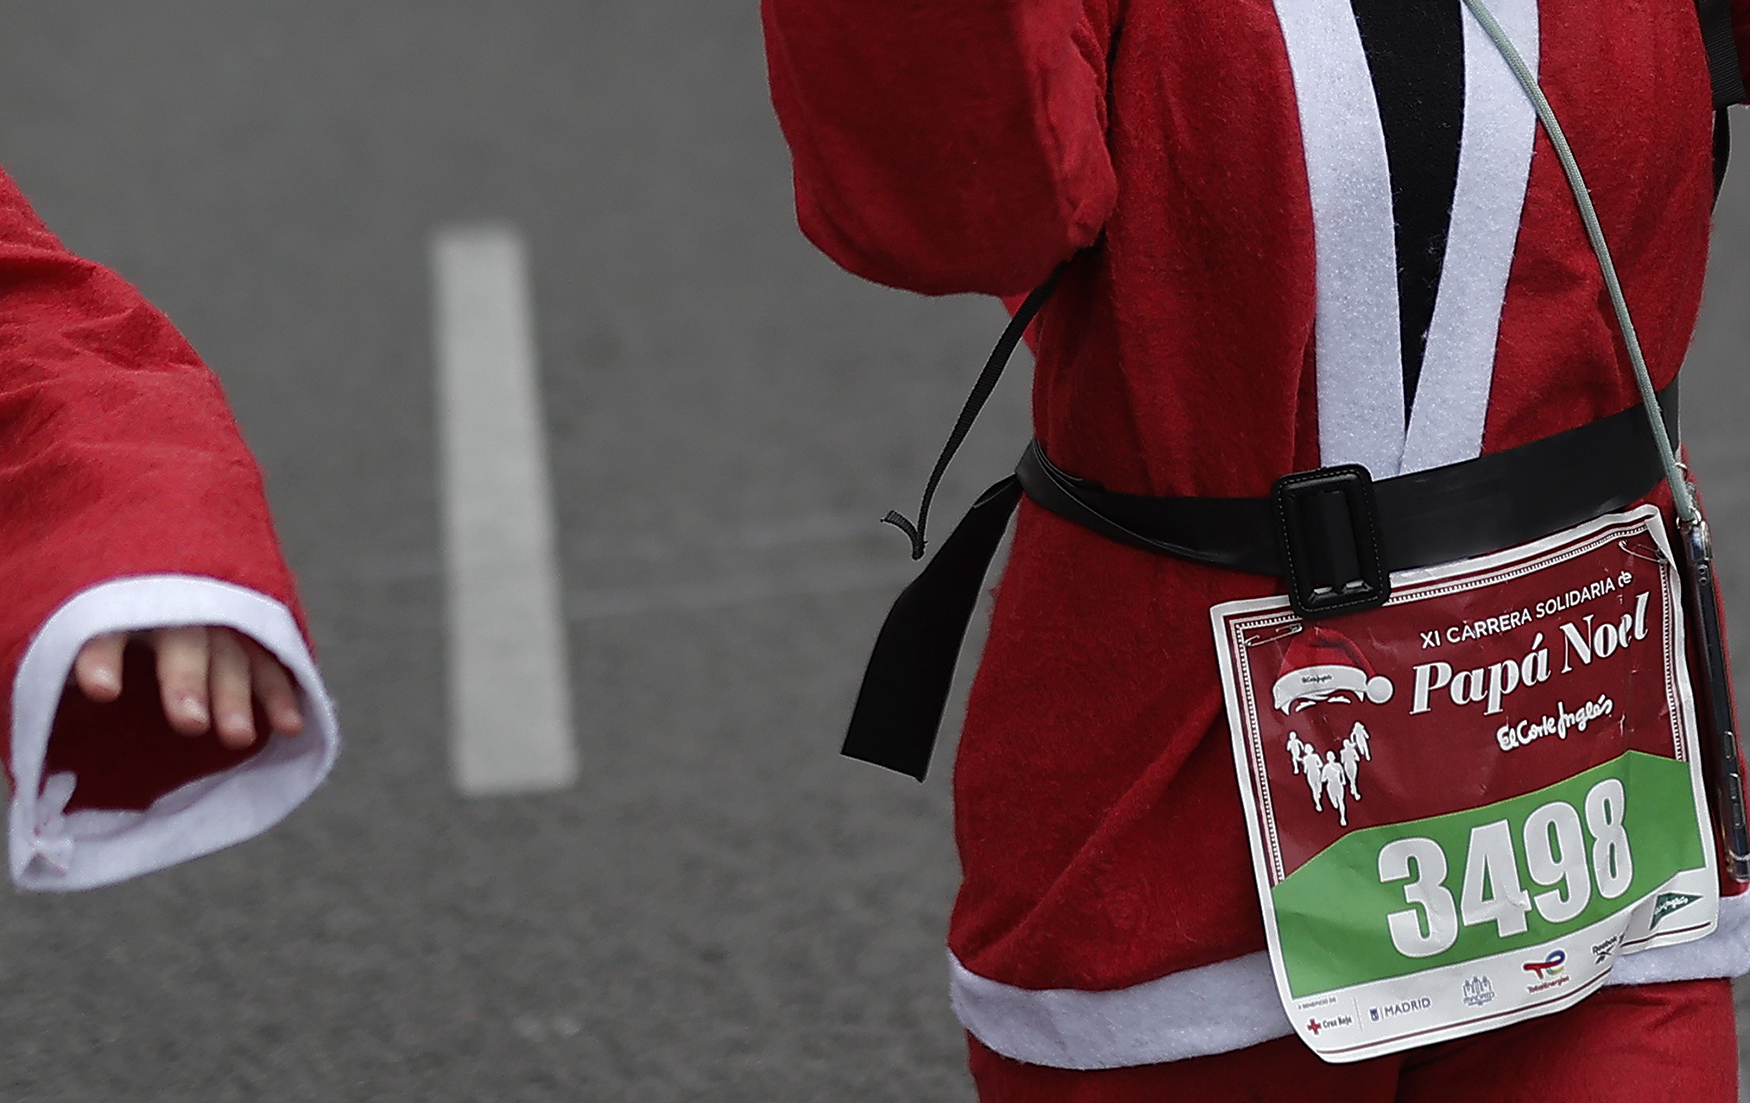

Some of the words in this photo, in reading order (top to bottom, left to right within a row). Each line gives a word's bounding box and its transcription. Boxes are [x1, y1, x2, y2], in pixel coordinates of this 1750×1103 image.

[1420, 630, 1441, 649] XI
[1446, 607, 1532, 643] CARRERA
[1536, 577, 1616, 618] SOLIDARIA
[1617, 570, 1633, 588] de
[1409, 632, 1551, 716] Papá
[1560, 591, 1650, 674] Noel
[1497, 723, 1515, 751] El
[1516, 717, 1557, 745] Corte
[1557, 694, 1613, 739] Inglés
[1378, 778, 1633, 958] 3498
[1384, 997, 1431, 1017] MADRID
